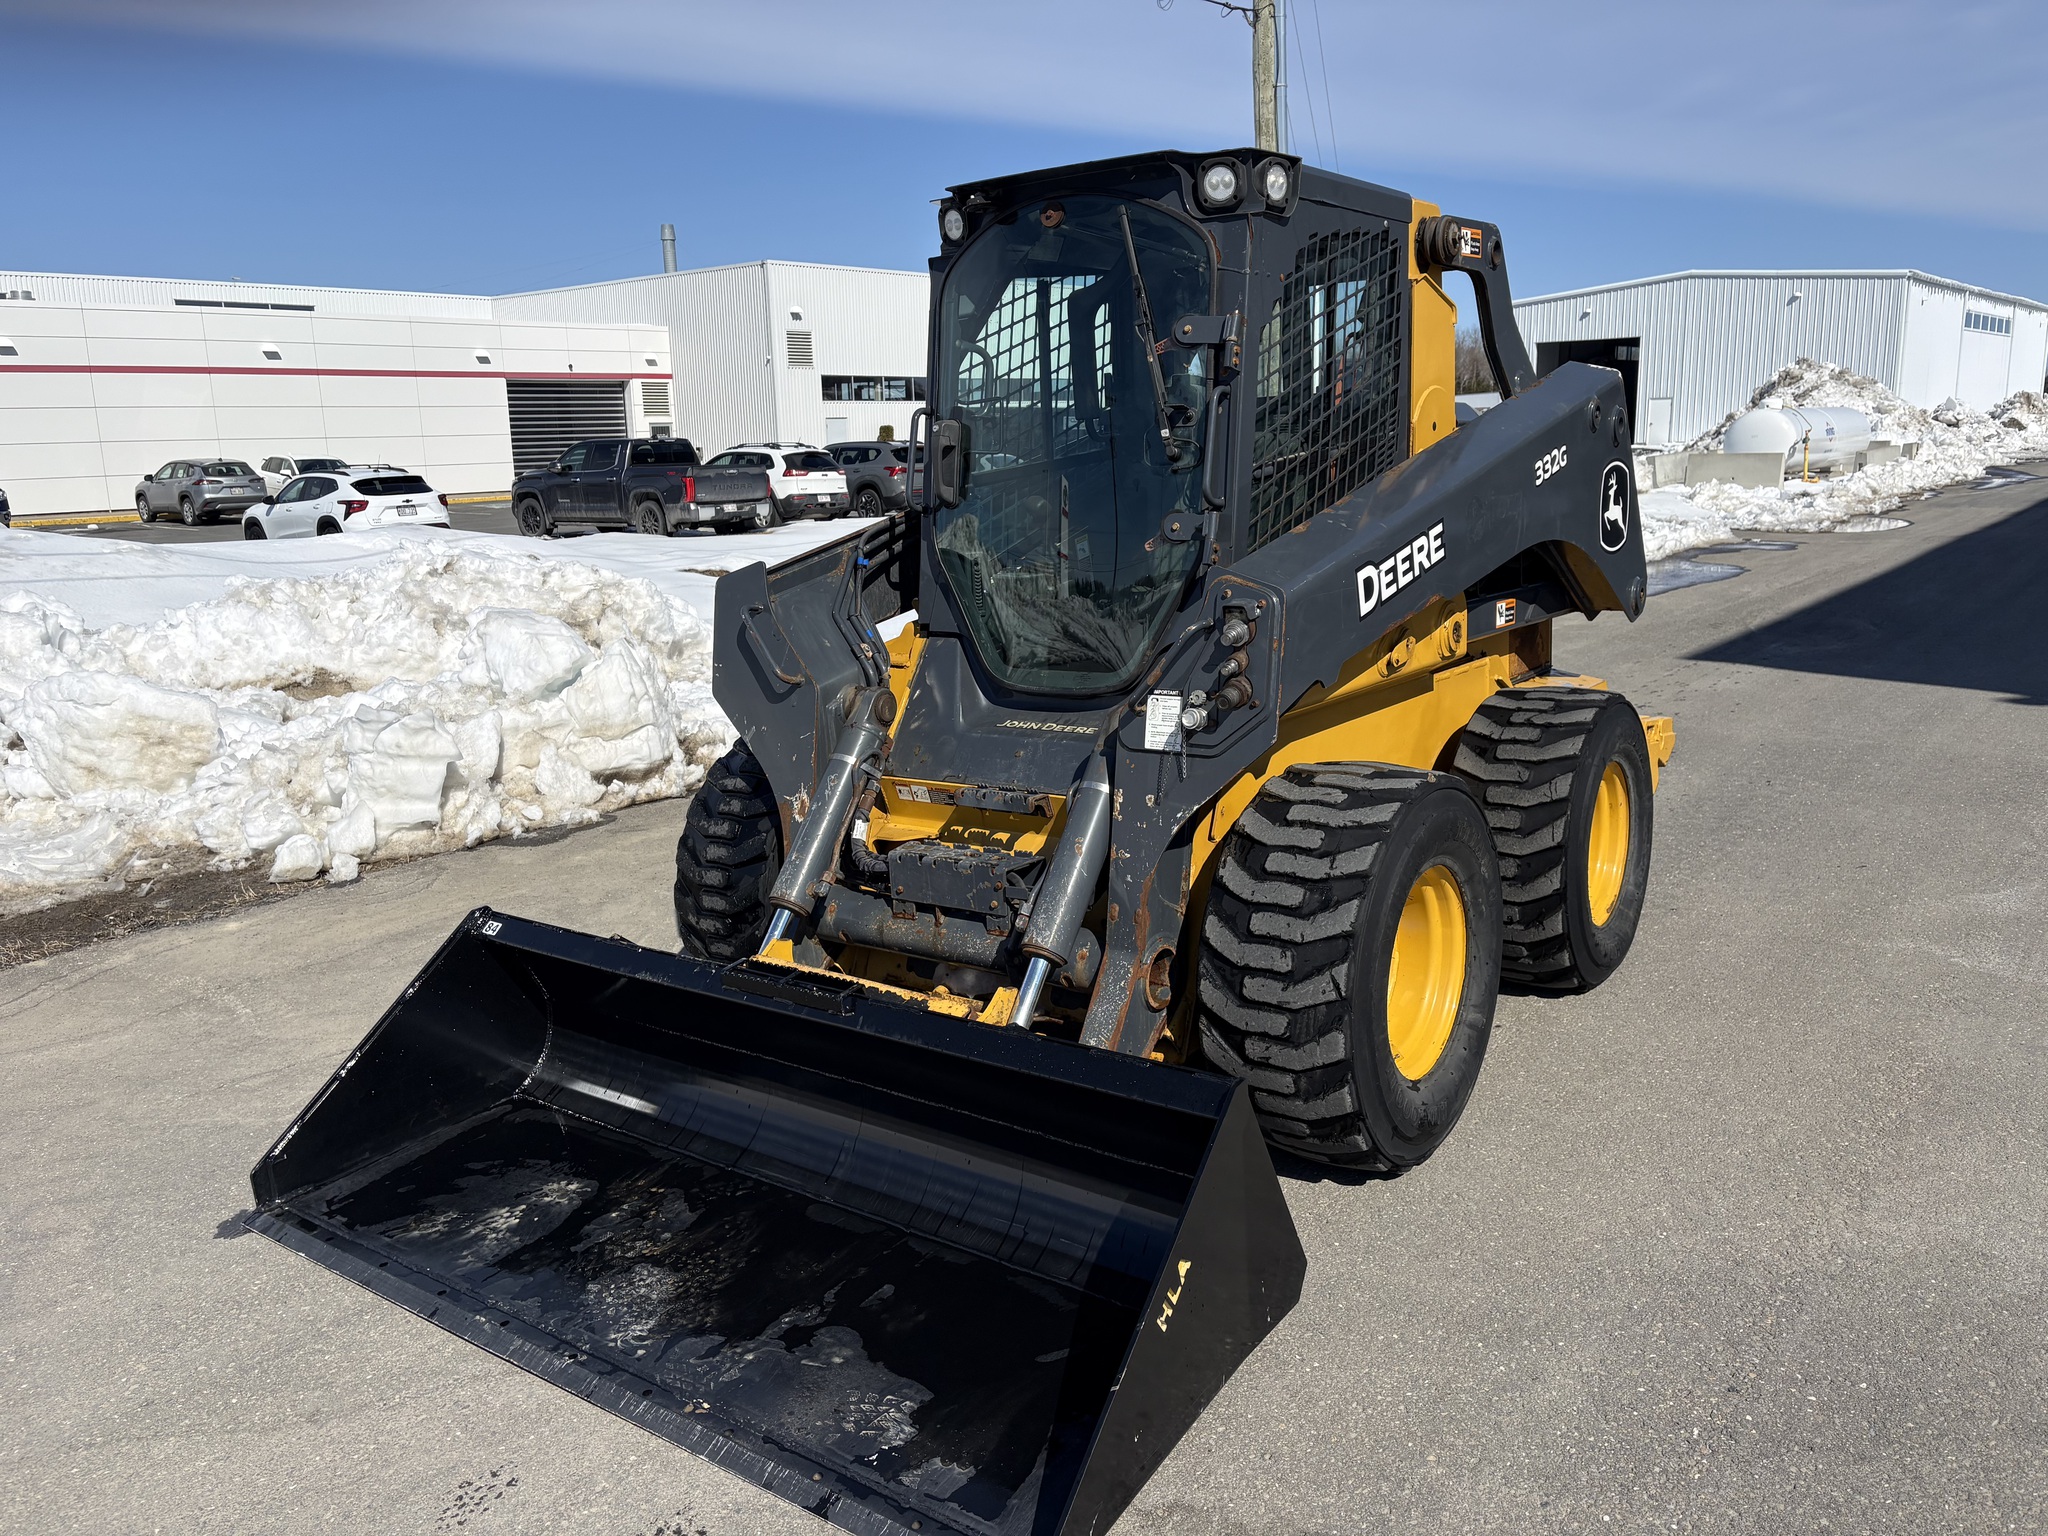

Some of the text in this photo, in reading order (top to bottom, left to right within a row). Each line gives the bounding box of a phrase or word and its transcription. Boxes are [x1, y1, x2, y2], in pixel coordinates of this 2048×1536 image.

[1534, 445, 1567, 486] 332G
[713, 483, 753, 491] TUNDRA
[1357, 522, 1445, 617] DEERE
[996, 719, 1098, 734] JOHN DEERE
[485, 922, 500, 934] 84
